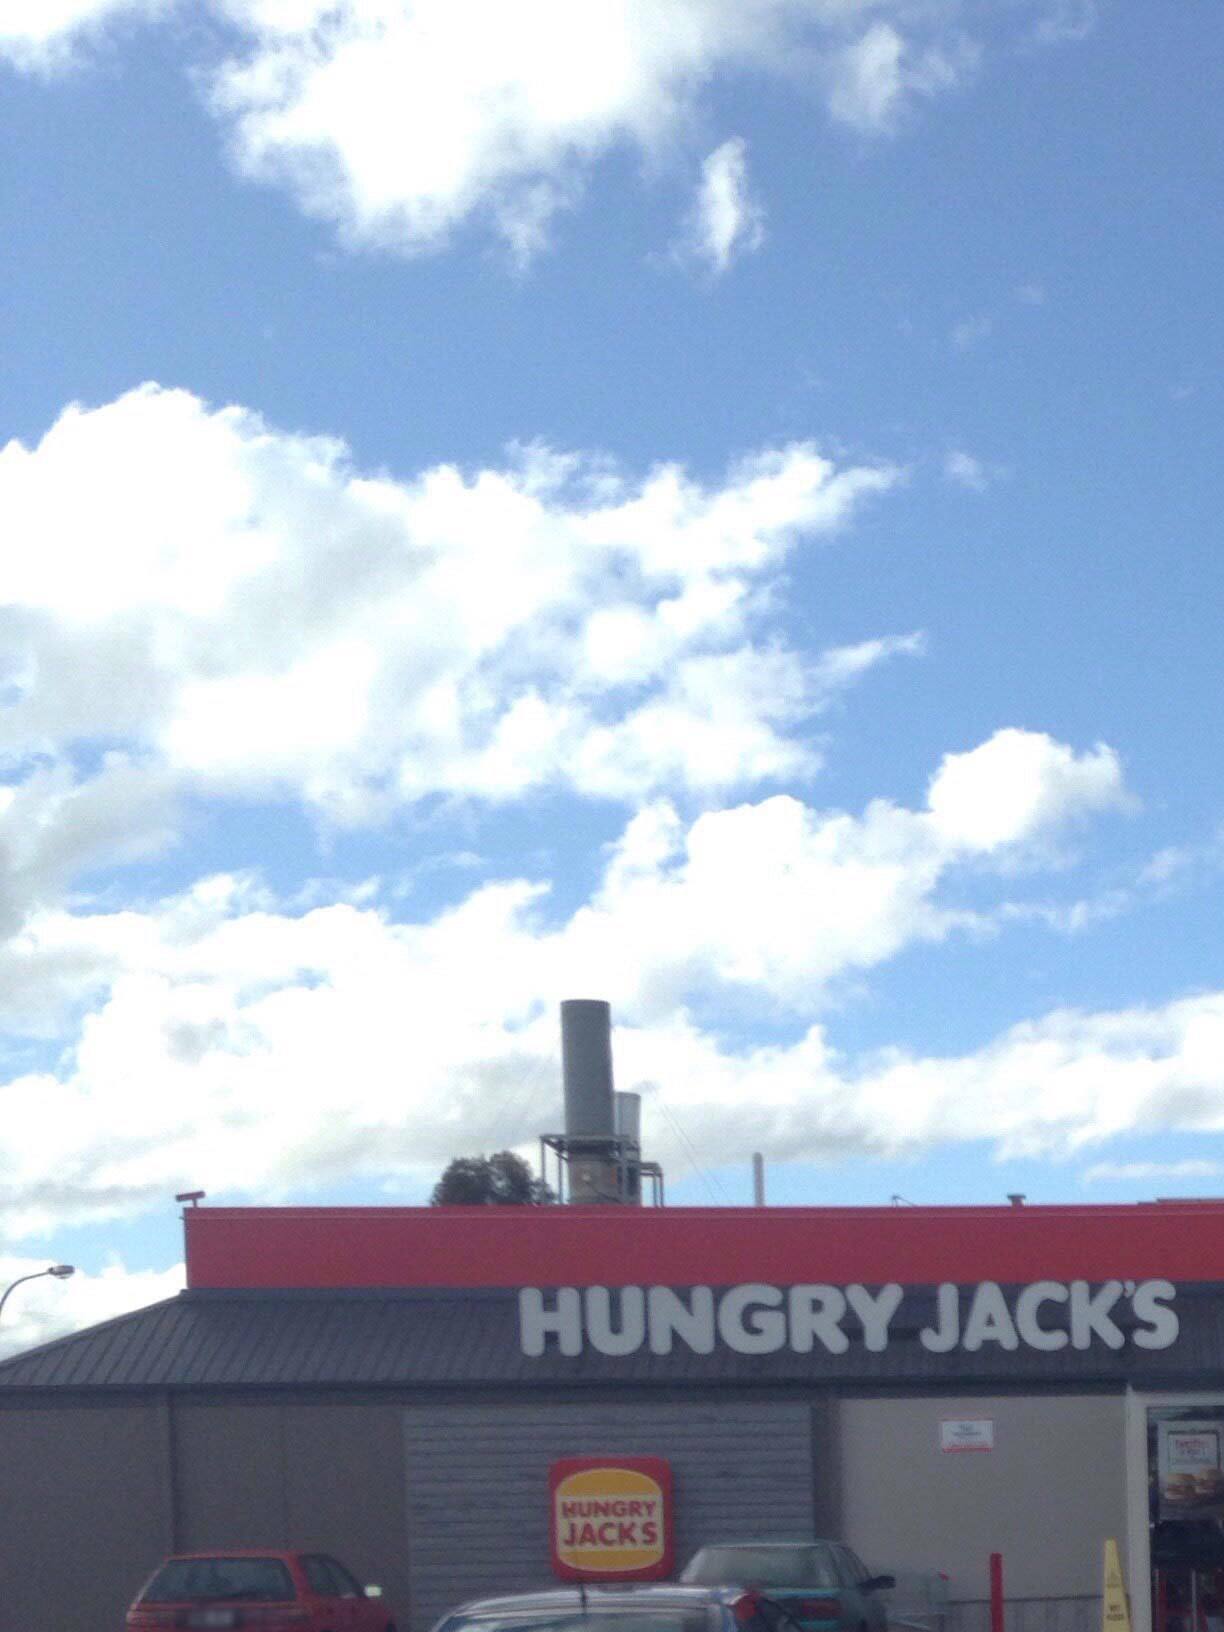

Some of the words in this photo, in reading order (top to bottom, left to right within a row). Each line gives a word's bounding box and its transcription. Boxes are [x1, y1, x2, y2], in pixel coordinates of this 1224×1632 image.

[518, 1283, 904, 1357] HUNGRY
[919, 1279, 1180, 1352] JACK'S
[562, 1501, 656, 1518] HUNGRY
